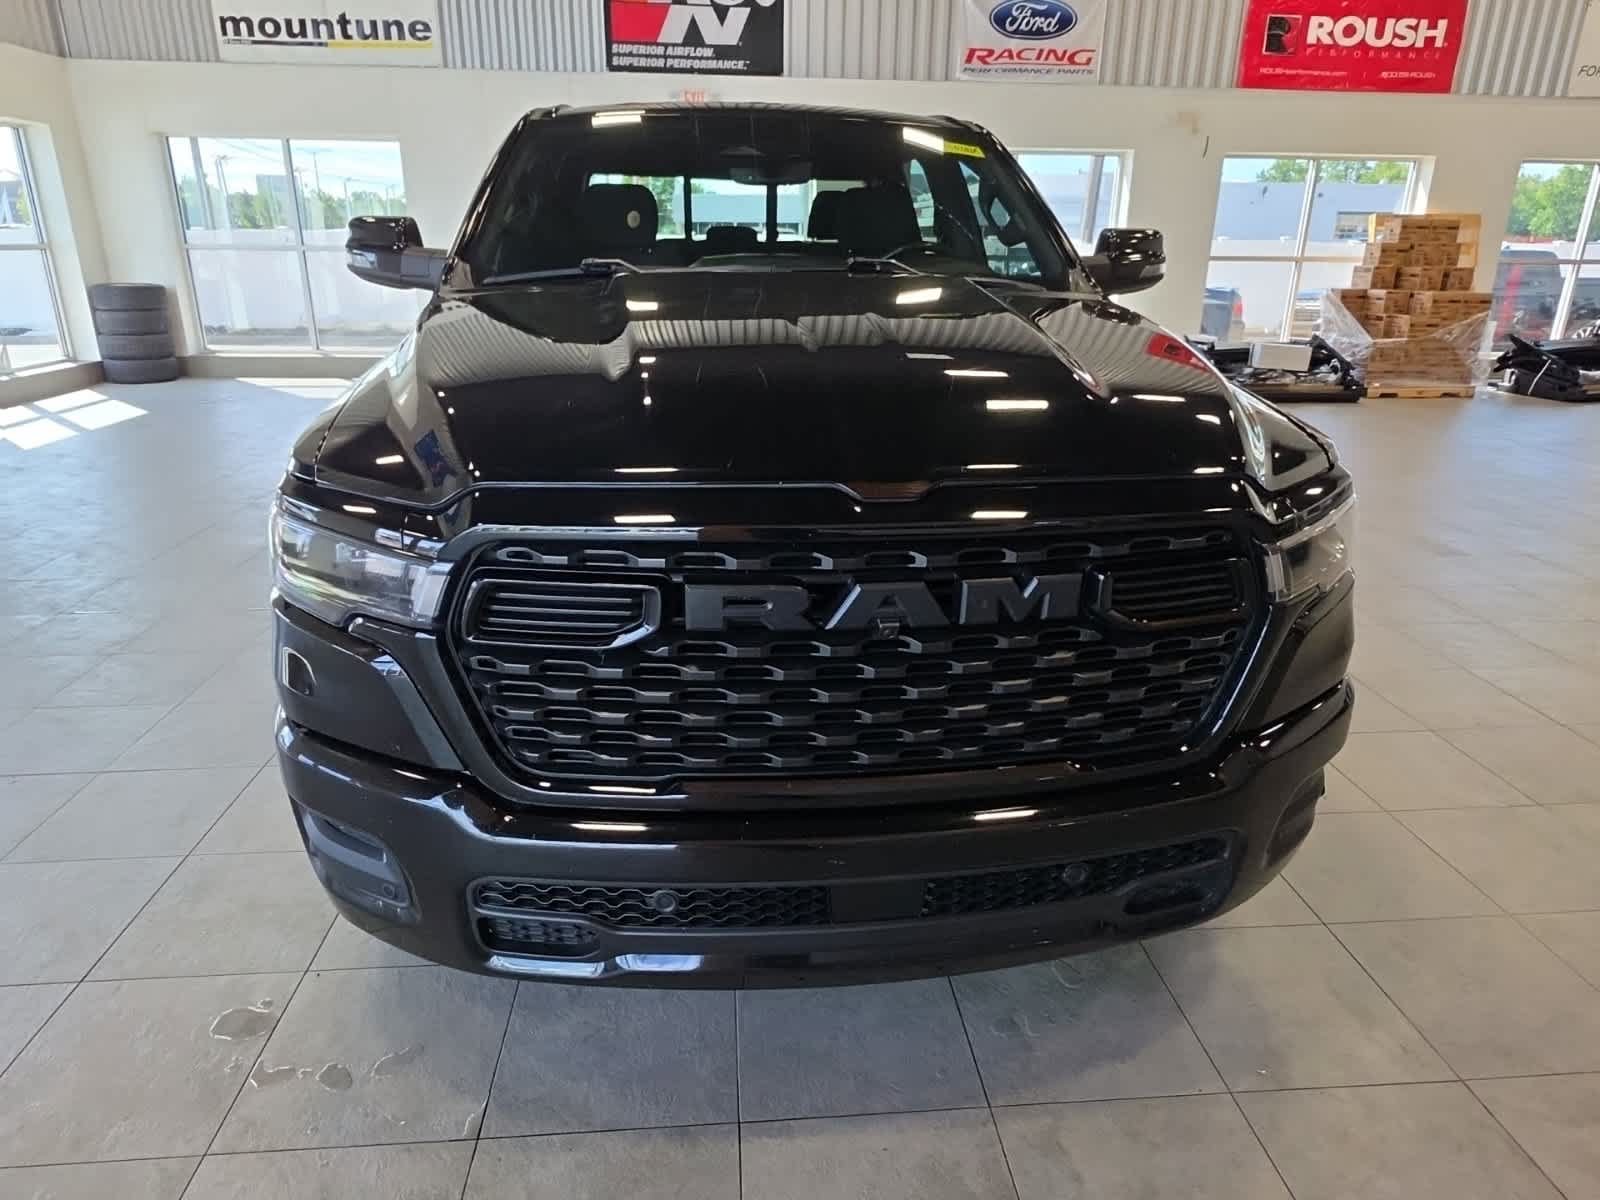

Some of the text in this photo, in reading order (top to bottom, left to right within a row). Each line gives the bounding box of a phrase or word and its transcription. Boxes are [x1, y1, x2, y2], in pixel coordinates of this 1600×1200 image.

[219, 12, 432, 41] mountune
[1005, 2, 1061, 32] Ford
[1306, 15, 1448, 48] ROUSH
[612, 43, 665, 56] SUPERIOR
[612, 56, 665, 67] SUPERIOR
[964, 47, 1096, 66] RACING
[685, 574, 1082, 632] RAM
